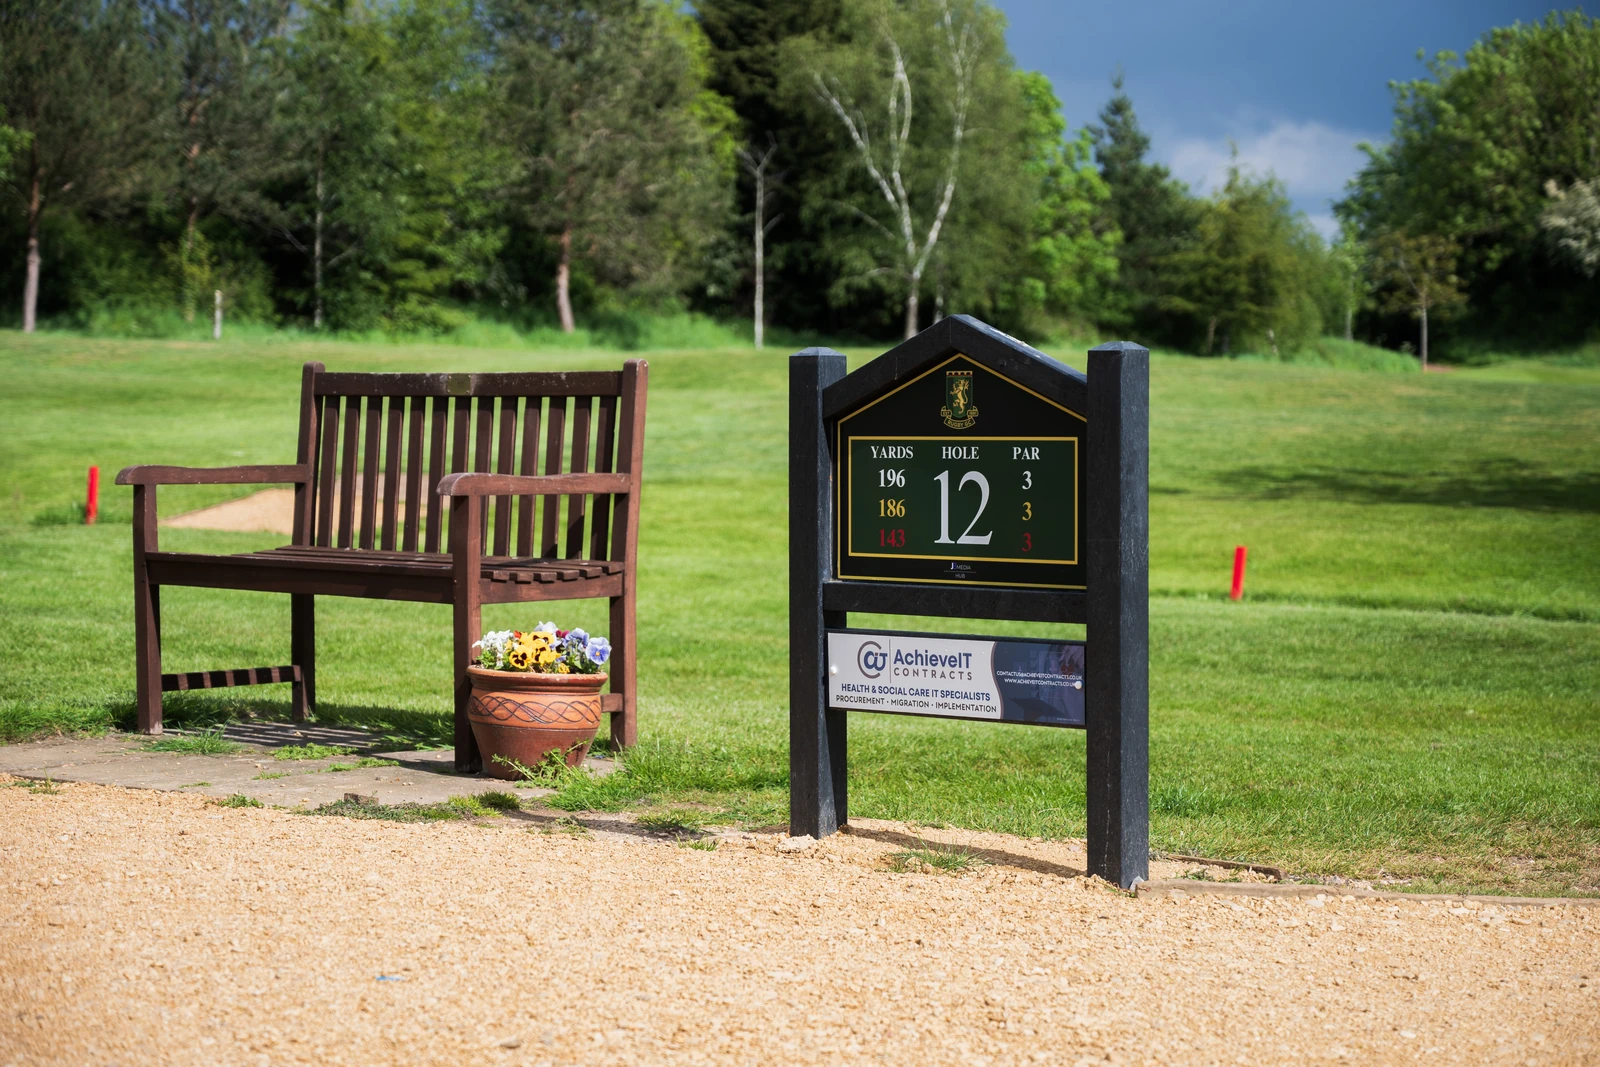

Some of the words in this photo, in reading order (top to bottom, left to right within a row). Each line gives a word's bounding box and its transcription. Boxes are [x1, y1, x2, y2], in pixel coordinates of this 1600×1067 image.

[870, 446, 914, 459] YARDS
[942, 446, 979, 460] HOLE
[1012, 447, 1040, 460] PAR
[878, 469, 905, 487] 196
[1022, 470, 1032, 490] 3
[879, 499, 905, 517] 186
[933, 470, 993, 545] 12
[1022, 501, 1032, 521] 3
[879, 528, 905, 548] 143
[1022, 533, 1032, 552] 3
[893, 649, 972, 669] AchieveIT
[893, 667, 973, 681] CONTRACTS
[841, 683, 870, 693] HEALTH
[871, 685, 877, 694] &
[878, 686, 907, 696] SOCIAL
[909, 687, 930, 697] CARE
[931, 689, 940, 698] IT
[940, 690, 991, 701] SPECIALISTS
[835, 694, 885, 705] PROCUREMENT
[891, 699, 930, 708] MIGRATION
[935, 702, 997, 713] IMPLEMENTATION
